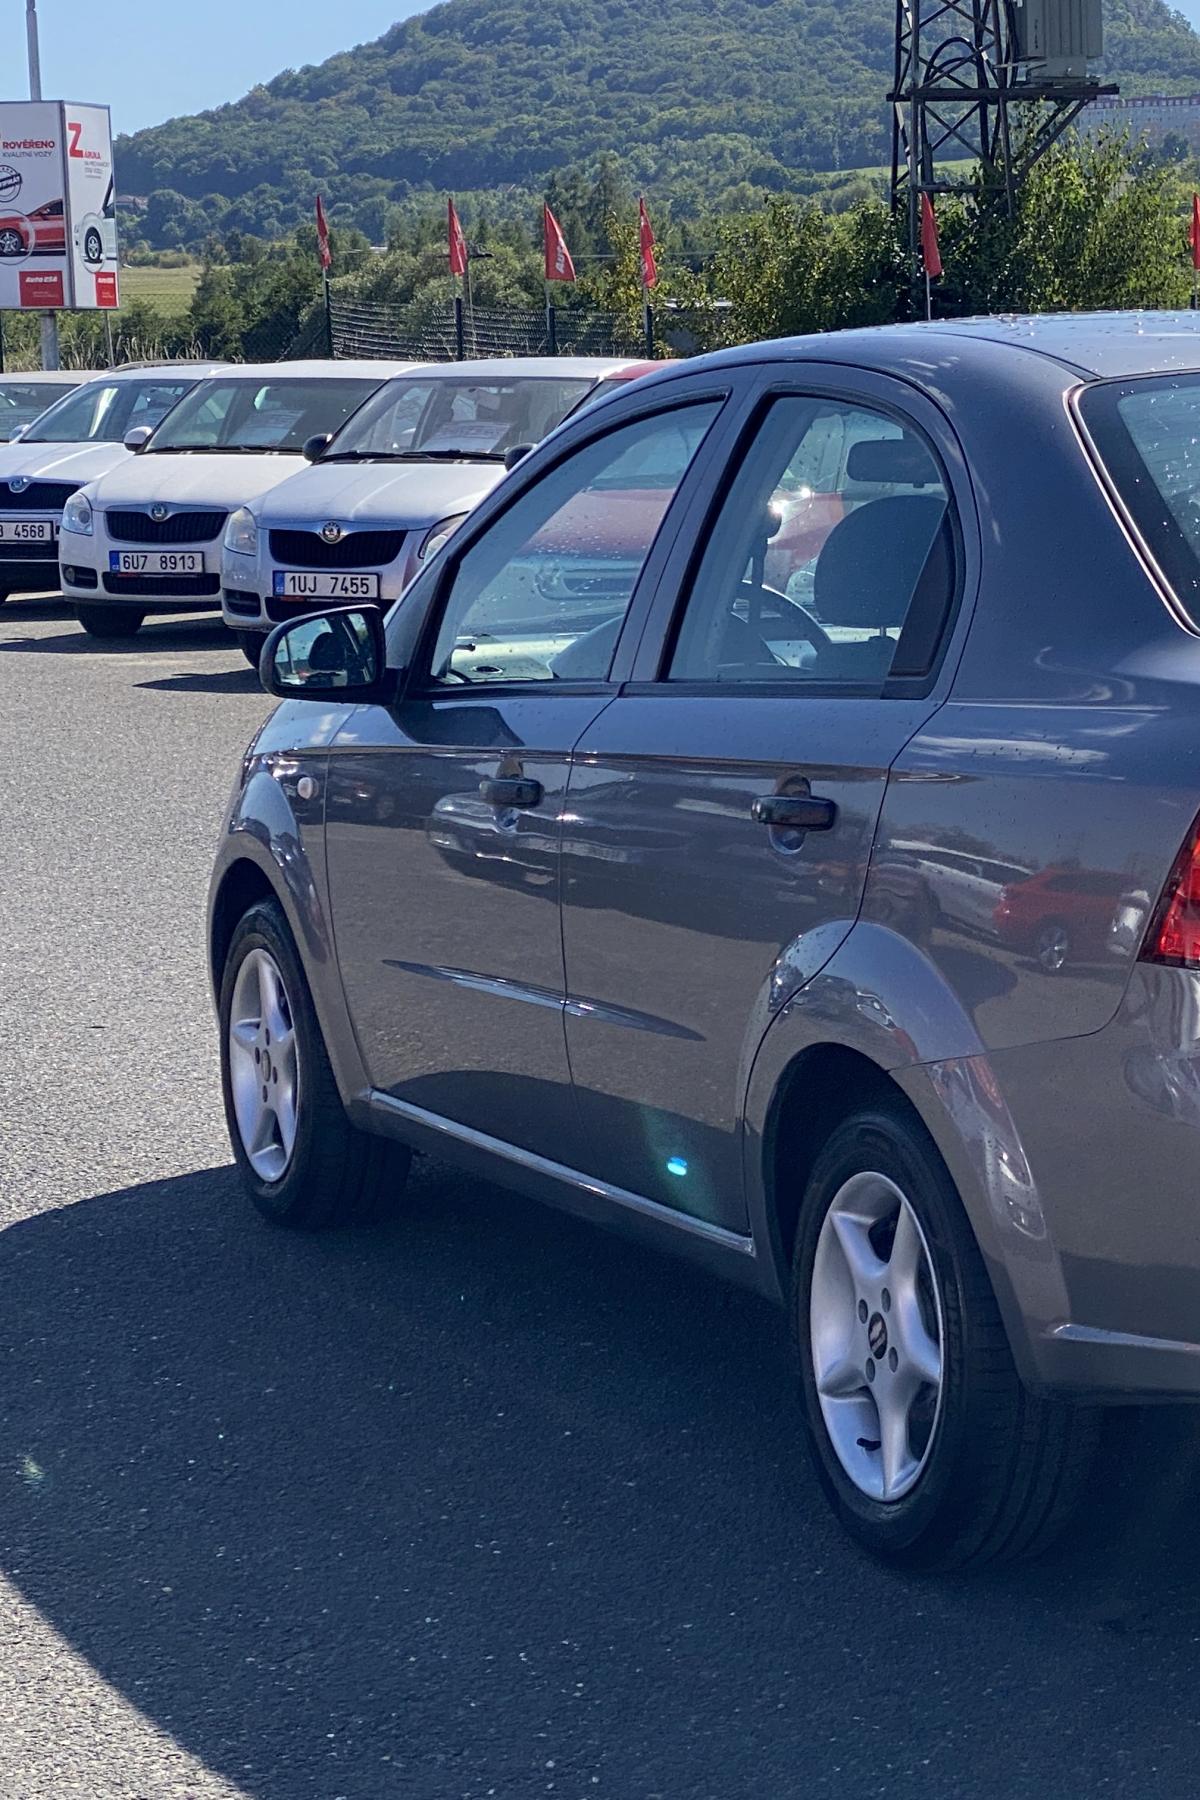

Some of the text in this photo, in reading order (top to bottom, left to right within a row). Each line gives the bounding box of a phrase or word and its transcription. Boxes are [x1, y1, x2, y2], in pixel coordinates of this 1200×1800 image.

[14, 524, 44, 538] 4568
[123, 555, 148, 570] 6U7
[160, 555, 195, 570] 8913
[289, 575, 317, 593] 1UJ
[329, 577, 370, 594] 7455
